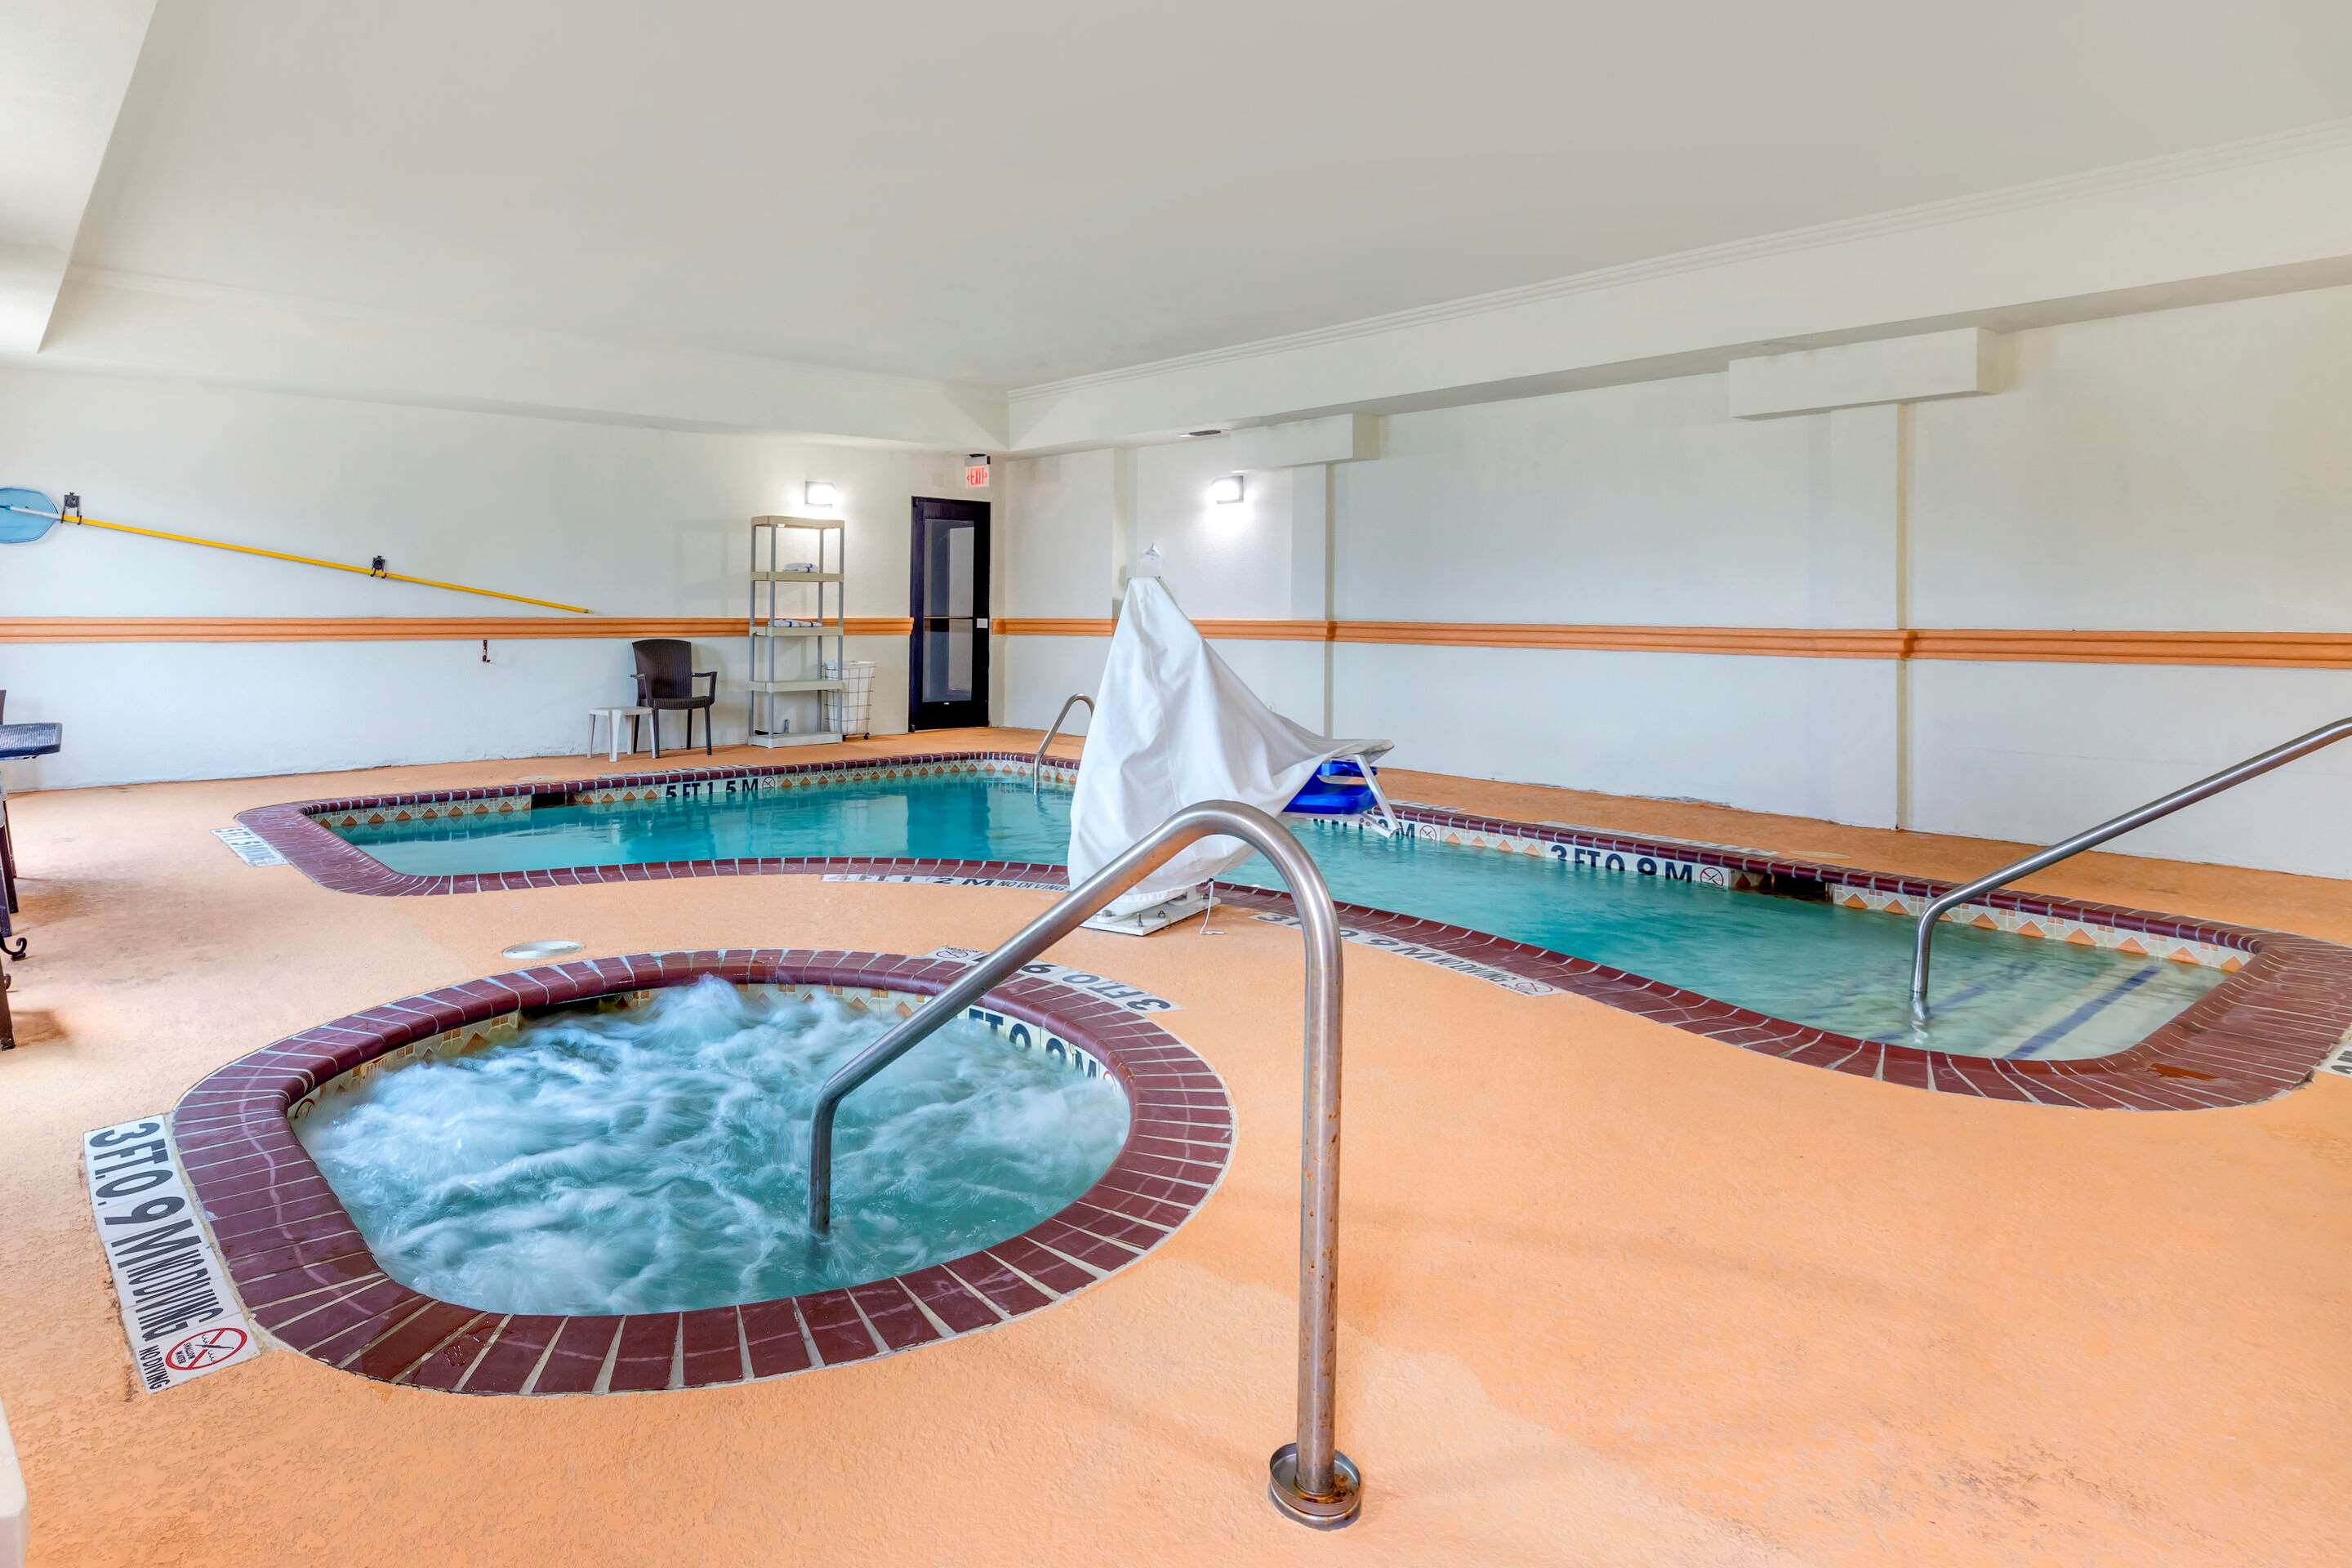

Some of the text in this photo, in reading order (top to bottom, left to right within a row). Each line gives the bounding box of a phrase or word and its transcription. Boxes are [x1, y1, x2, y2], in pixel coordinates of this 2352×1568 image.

[969, 469, 985, 485] EXIT
[666, 785, 677, 797] 5
[683, 782, 702, 797] FT
[742, 777, 759, 792] M
[1551, 844, 1568, 862] 3
[1574, 848, 1601, 867] FT
[1665, 861, 1693, 883] M
[962, 878, 994, 887] M
[997, 880, 1015, 888] NO
[1016, 881, 1067, 892] DIVING
[1126, 999, 1171, 1011] 3
[89, 1122, 161, 1147] 3
[111, 1218, 203, 1269] M
[127, 1250, 205, 1285] NO
[133, 1267, 224, 1342] DIVING
[139, 1345, 171, 1390] NO DIVING
